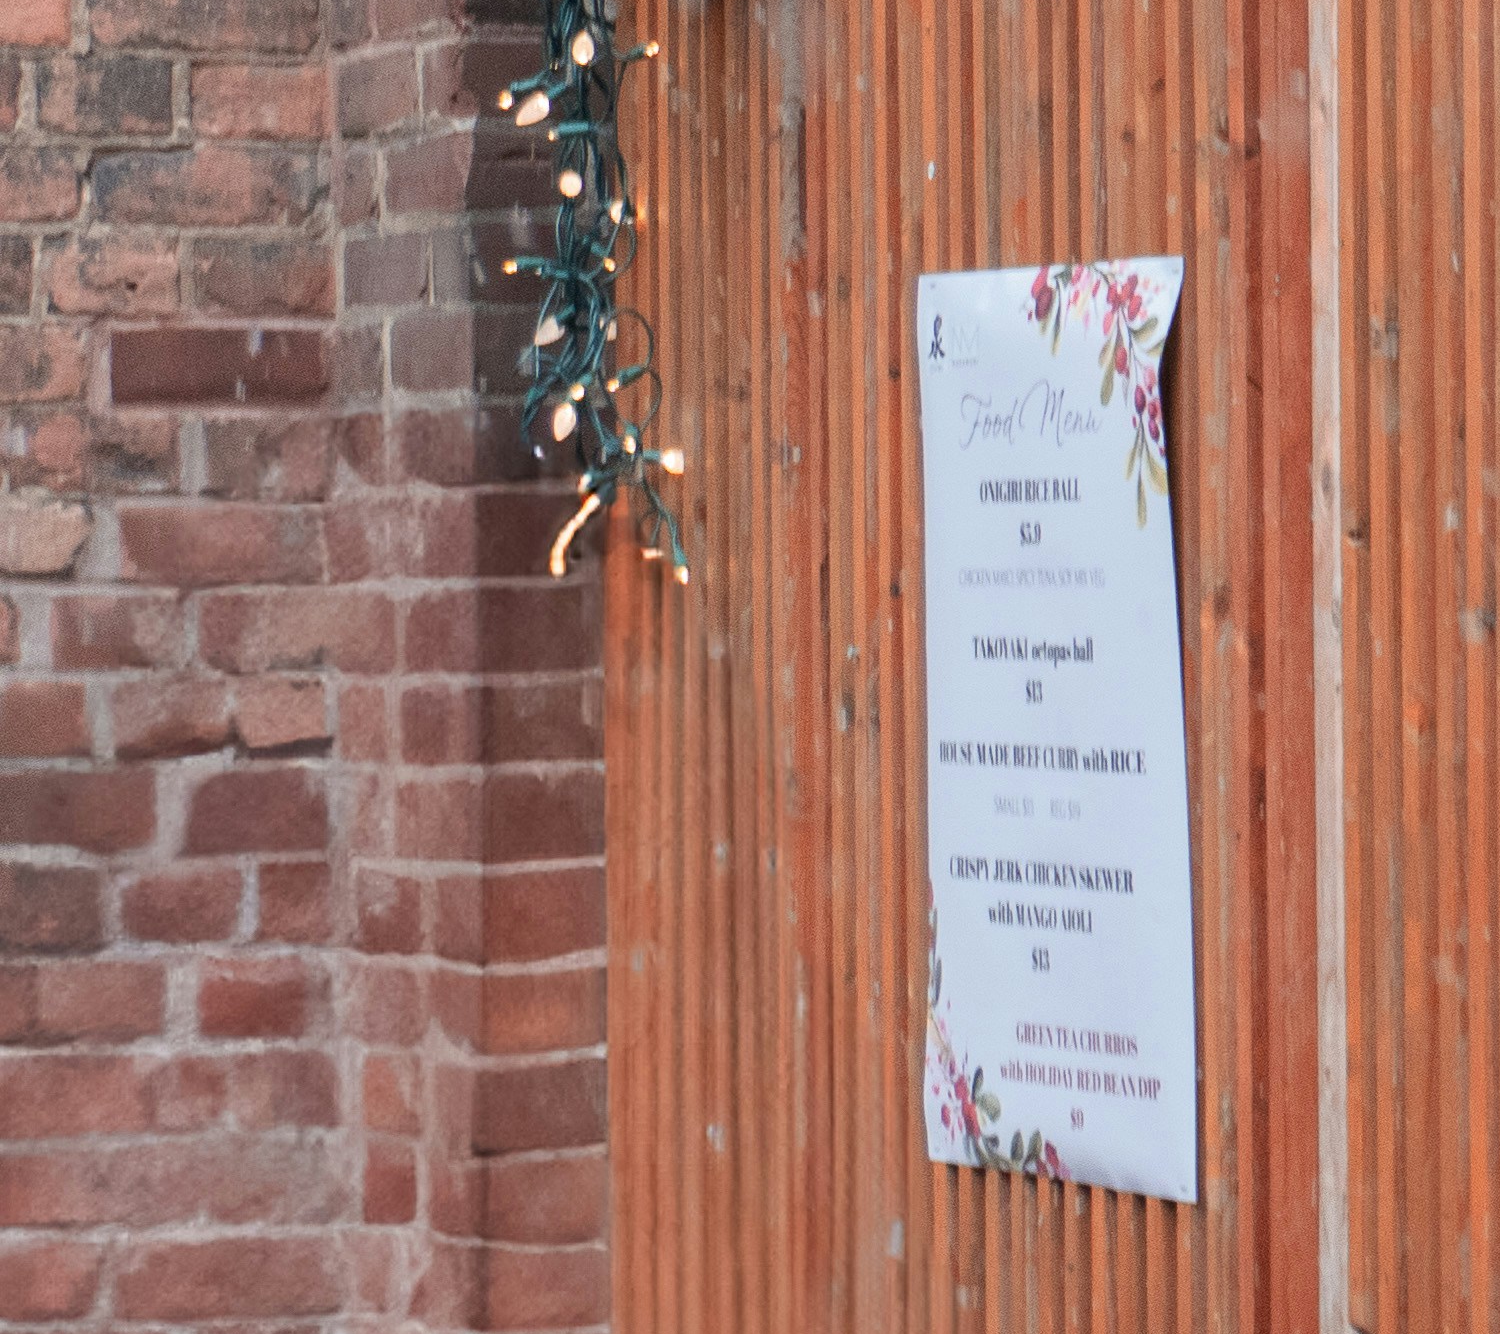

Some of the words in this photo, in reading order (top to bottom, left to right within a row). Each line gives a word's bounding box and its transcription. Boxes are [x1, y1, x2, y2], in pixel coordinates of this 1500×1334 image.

[959, 391, 1020, 450] Food
[1018, 378, 1102, 448] Menu
[1024, 477, 1050, 503] RICE
[1052, 475, 1081, 503] BALL
[972, 636, 1028, 660] TAKOYAKI
[1073, 636, 1094, 664] ball
[939, 741, 974, 766] HOUSE
[975, 743, 1011, 768] MADE
[1012, 744, 1042, 770] BEEF
[1042, 746, 1080, 771] CURRY
[1082, 748, 1109, 773] with
[1110, 749, 1147, 775] RICE
[949, 855, 990, 883] CRISPY
[993, 858, 1023, 885] JERK
[1025, 861, 1077, 890] CHICKEN
[1079, 865, 1134, 895] SKEWER
[987, 900, 1014, 927] with
[1015, 902, 1058, 931] MANGO
[1061, 907, 1093, 934] AIOLI
[1015, 1021, 1055, 1048] GREEN
[1056, 1026, 1079, 1052] TEA
[1079, 1028, 1139, 1060] CHURROS
[1000, 1059, 1024, 1083] with
[1025, 1062, 1075, 1090] HOLIDAY
[1076, 1068, 1102, 1094] RED
[1103, 1071, 1137, 1099] BEAN
[1137, 1076, 1162, 1102] DIP
